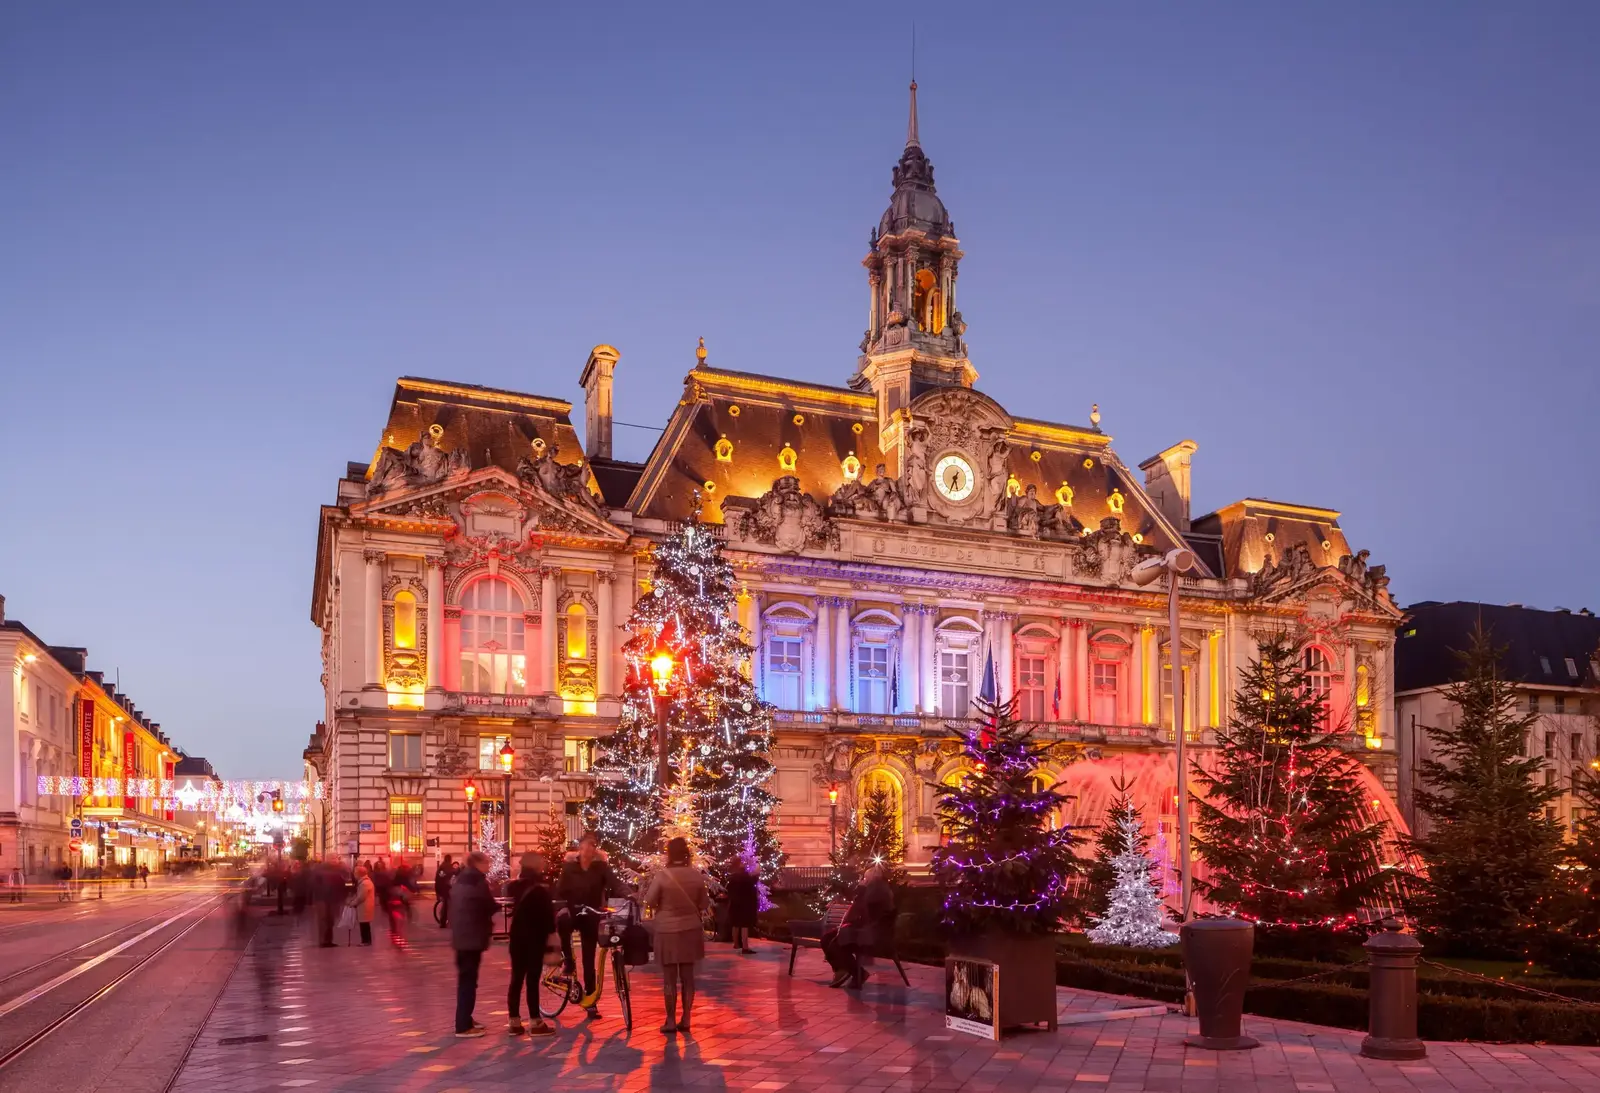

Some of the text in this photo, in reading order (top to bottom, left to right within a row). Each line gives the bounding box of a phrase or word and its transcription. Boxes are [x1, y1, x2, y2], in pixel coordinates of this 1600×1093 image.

[899, 543, 1021, 567] HOTEL DE VILLE
[84, 712, 92, 748] LAFAYETTE
